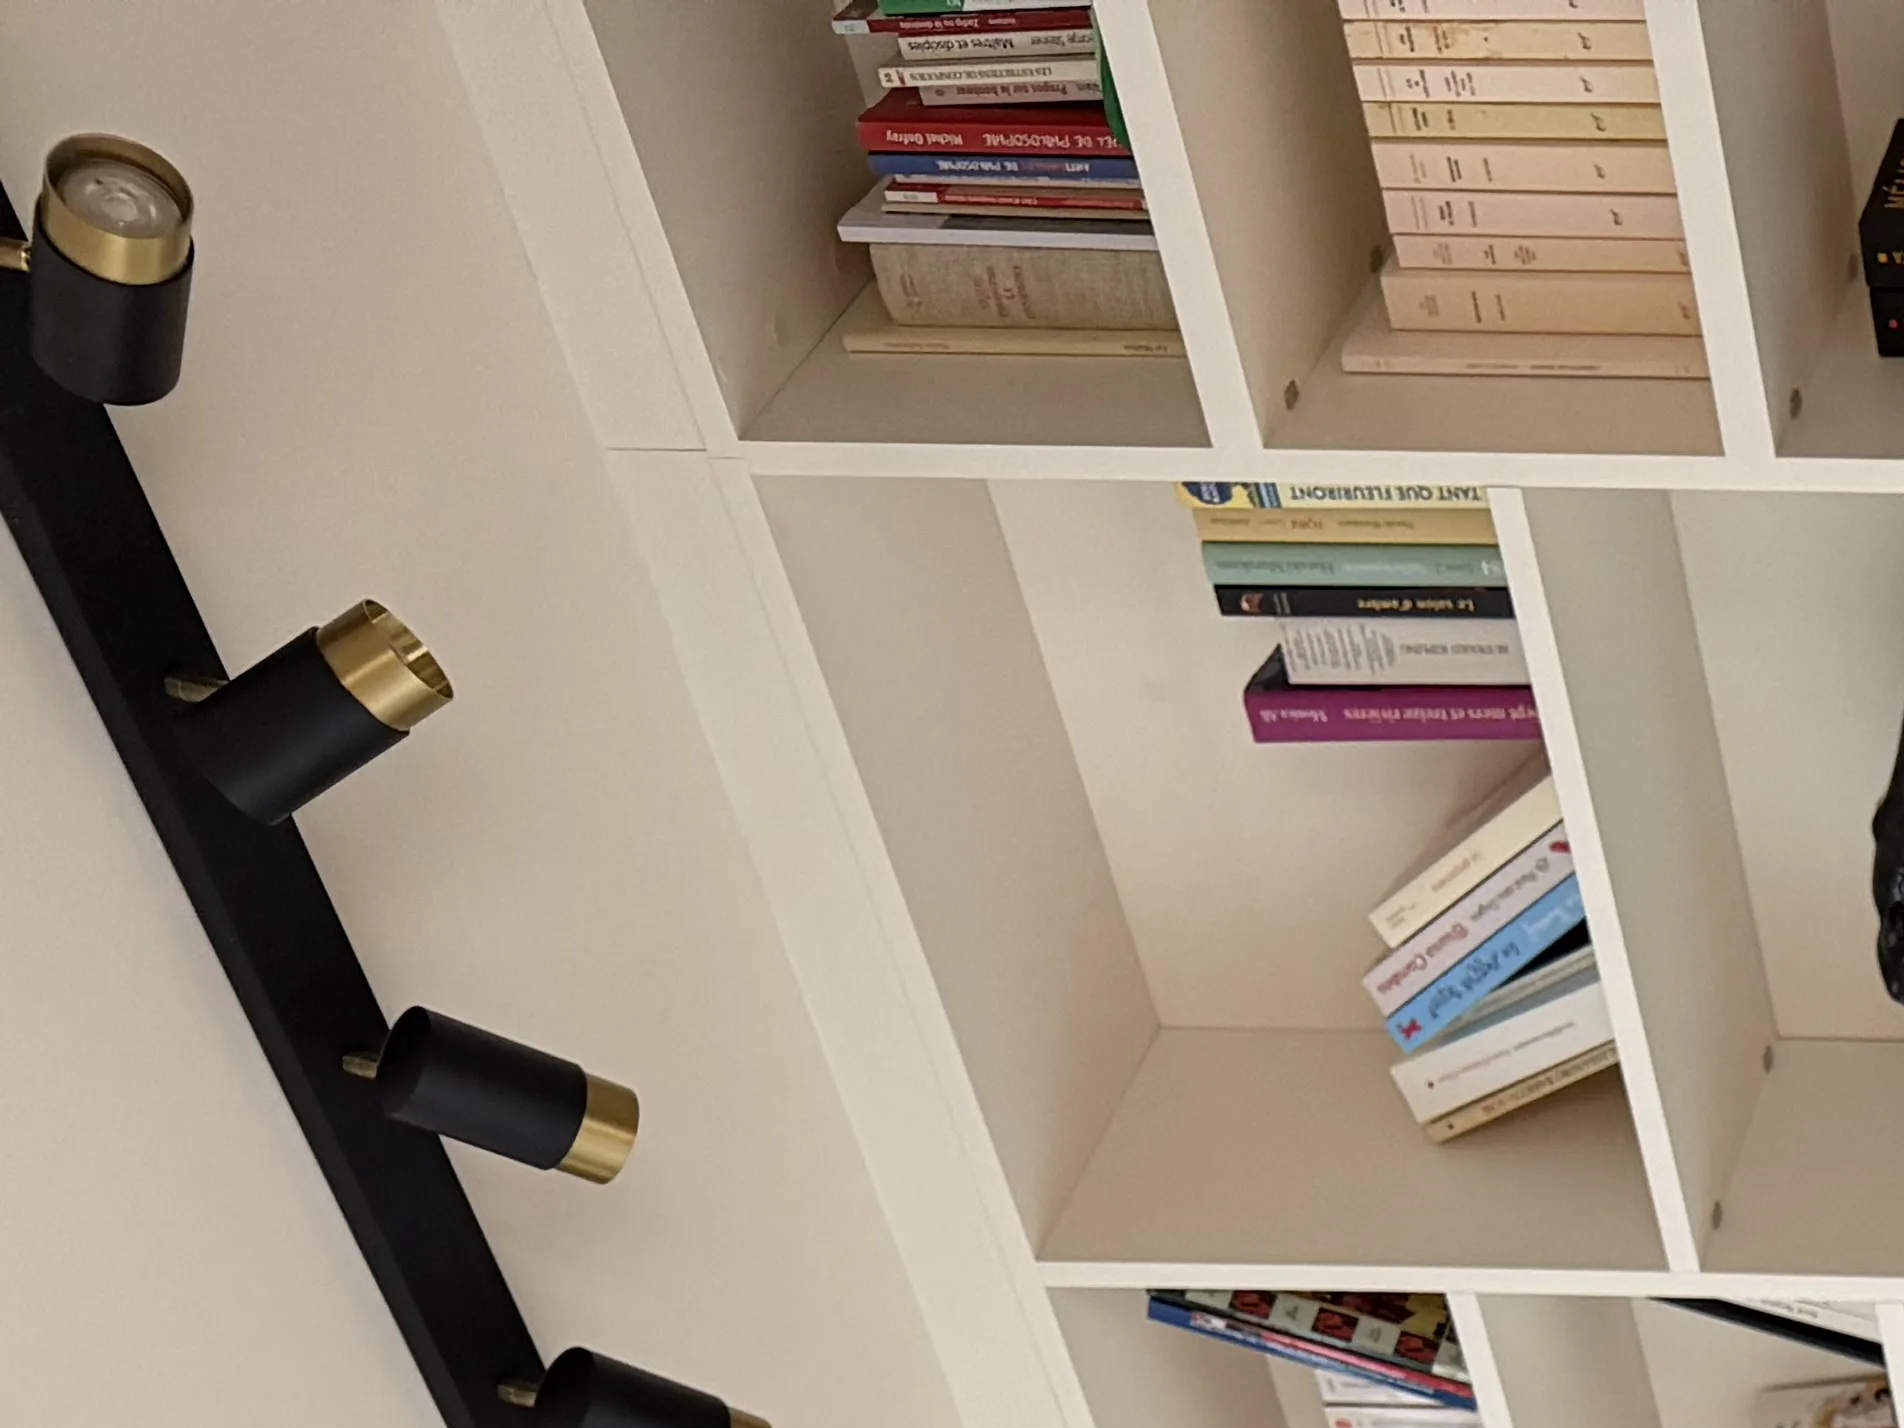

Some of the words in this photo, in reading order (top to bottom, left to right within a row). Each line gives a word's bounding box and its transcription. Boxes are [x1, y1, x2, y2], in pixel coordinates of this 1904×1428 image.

[907, 36, 954, 52] disciples
[956, 40, 968, 50] et
[972, 37, 1013, 51] Maîtres
[886, 129, 923, 146] Onfray
[925, 132, 963, 146] Michel
[983, 132, 1070, 147] PHILOSOPHIE
[1074, 135, 1092, 148] DE
[935, 160, 1001, 171] PHILOSOPHIE
[1289, 485, 1393, 501] FLEURIRONT
[1394, 484, 1434, 501] QUE
[1438, 486, 1480, 502] TANT
[1456, 598, 1475, 611] Le
[1343, 707, 1400, 724] rivières
[1401, 706, 1448, 723] treize
[1449, 708, 1467, 722] et
[1468, 707, 1506, 721] mers
[1508, 703, 1537, 723] ept
